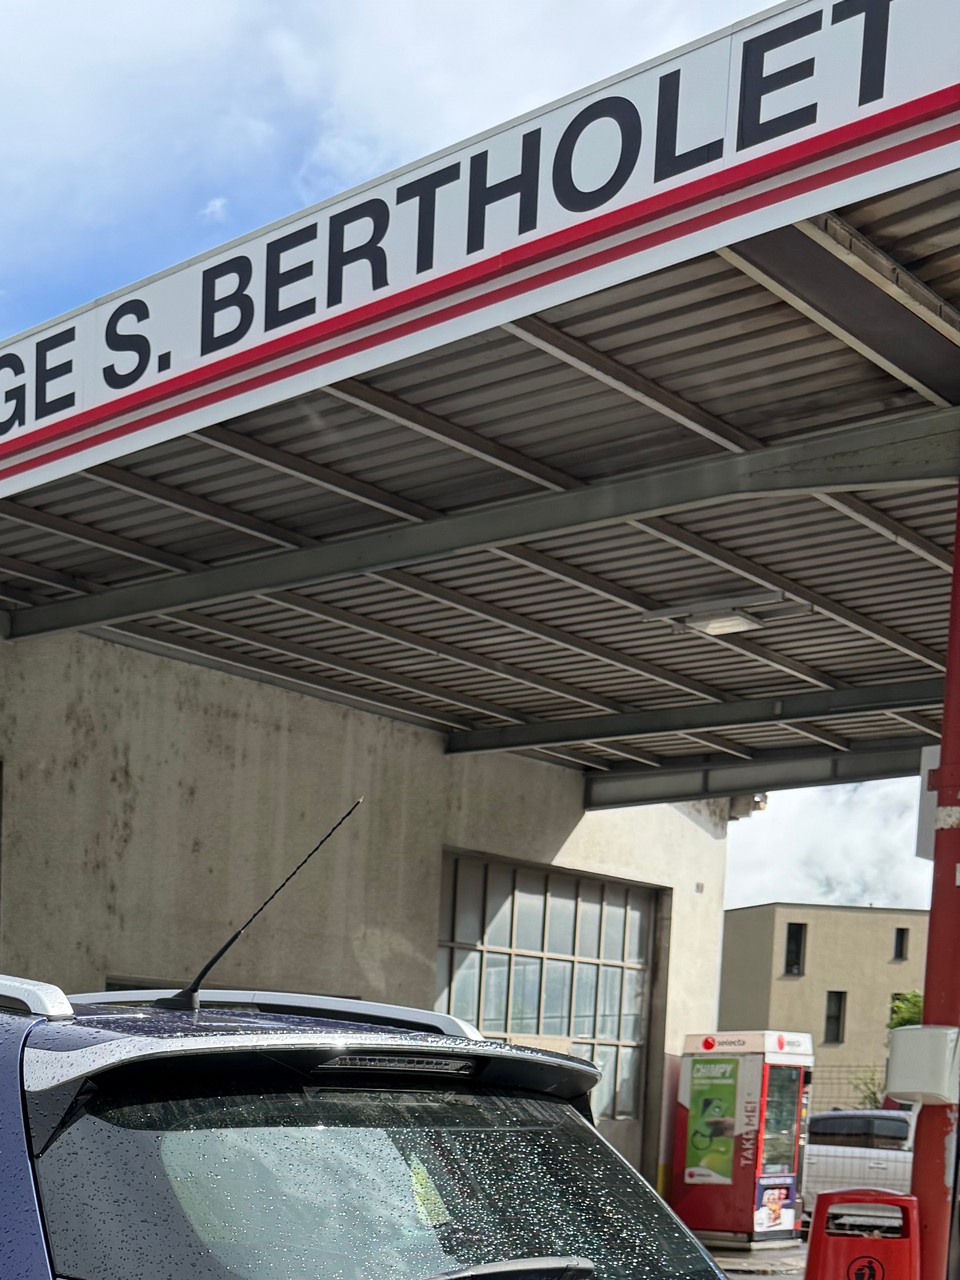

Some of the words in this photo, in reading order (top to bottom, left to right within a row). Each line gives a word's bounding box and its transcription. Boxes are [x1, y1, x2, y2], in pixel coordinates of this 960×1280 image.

[102, 298, 172, 390] S.
[200, 0, 890, 357] BERTHOLET
[693, 1063, 734, 1077] CHIMPY
[740, 1130, 756, 1167] TAKE
